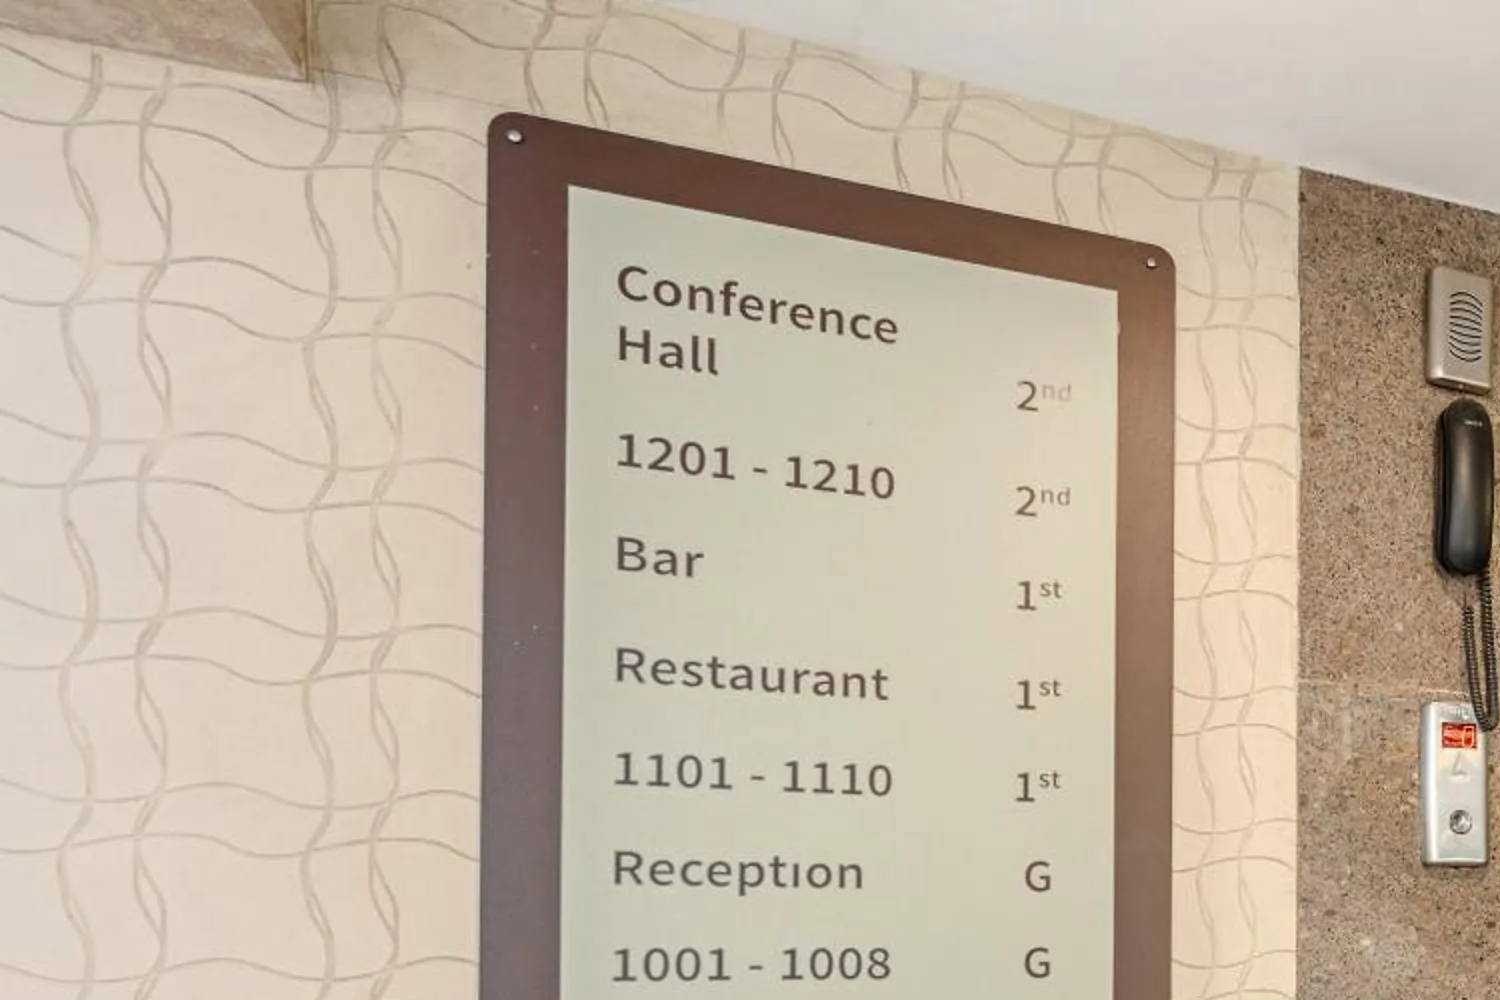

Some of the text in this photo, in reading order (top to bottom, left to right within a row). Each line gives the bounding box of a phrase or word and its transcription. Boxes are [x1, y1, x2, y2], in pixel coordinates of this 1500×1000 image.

[617, 265, 899, 345] Conference
[618, 325, 719, 377] Hall
[1016, 380, 1073, 413] 2nd
[616, 433, 896, 500] 1201 - 1210
[1014, 486, 1071, 518] 2nd
[616, 535, 705, 579] Bar
[1016, 580, 1063, 612] 1st
[615, 646, 889, 701] Restaurant
[1015, 679, 1062, 711] 1st
[613, 751, 734, 791] 1101
[782, 759, 893, 798] 1110
[1014, 771, 1061, 804] 1st
[613, 850, 863, 897] Reception
[1024, 860, 1052, 894] G
[611, 947, 732, 983] 1001
[780, 946, 892, 982] 1008
[1023, 946, 1052, 979] G
